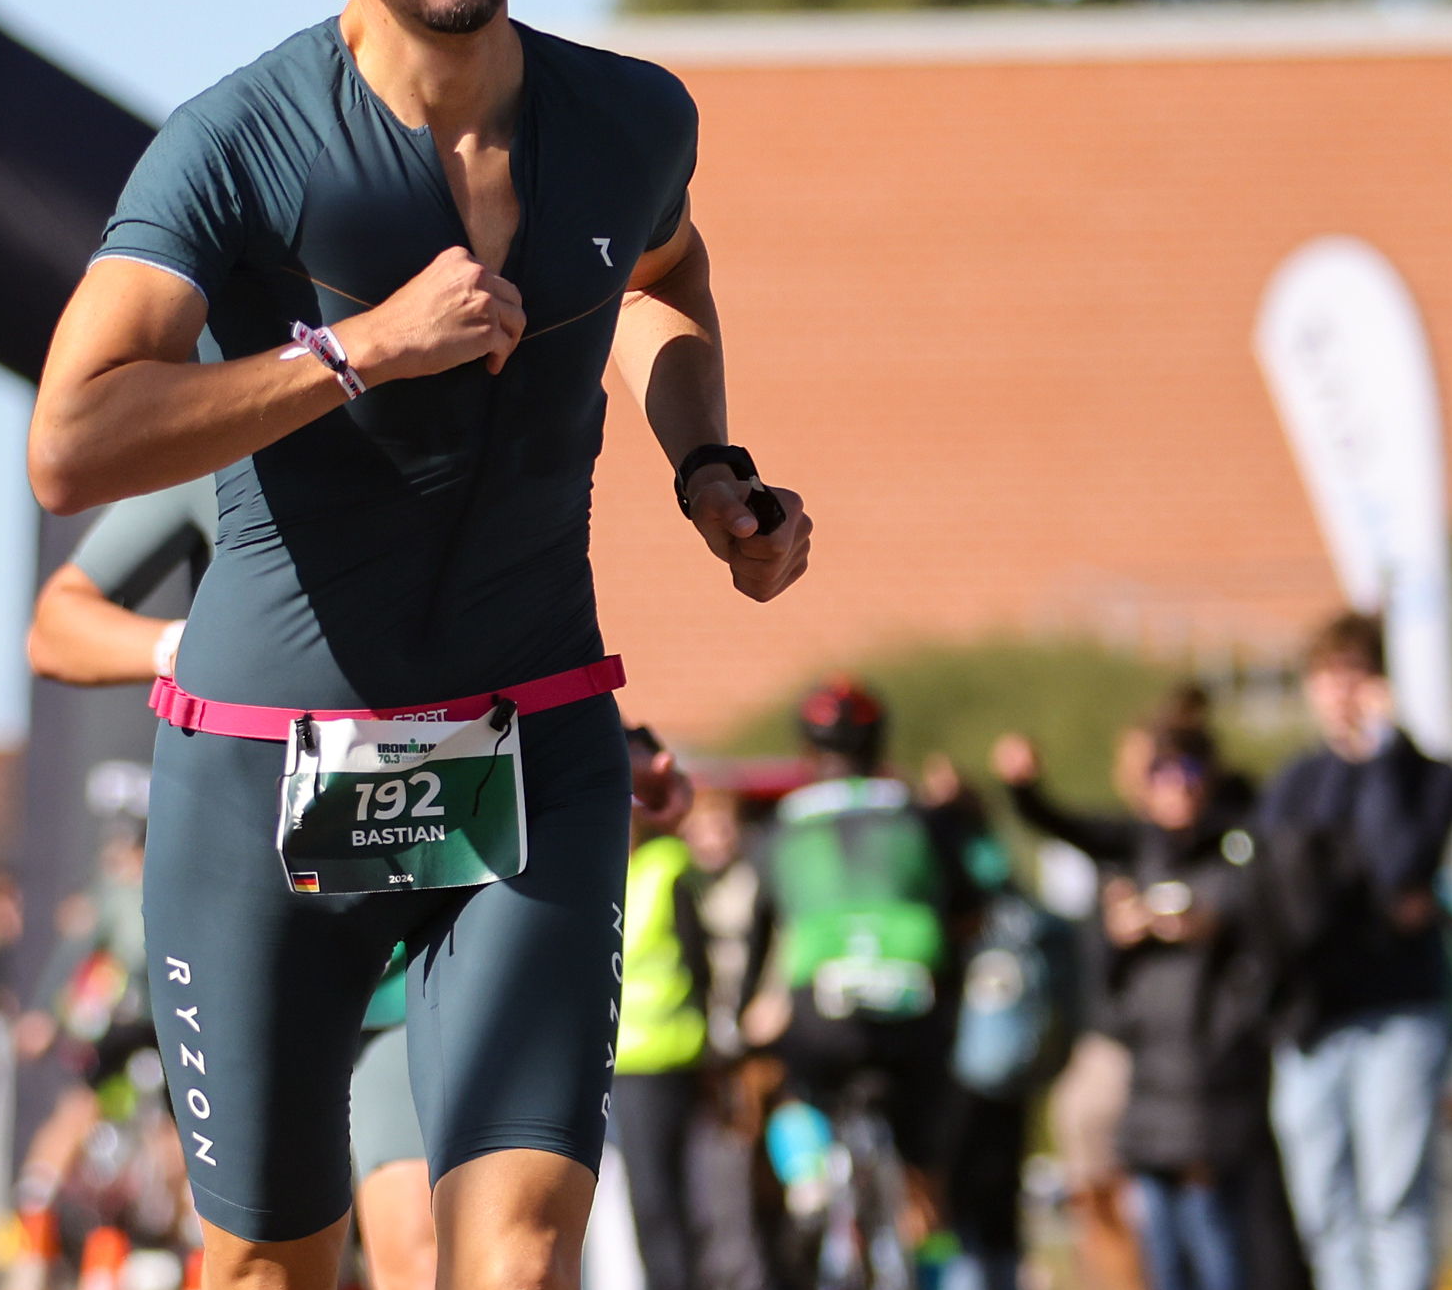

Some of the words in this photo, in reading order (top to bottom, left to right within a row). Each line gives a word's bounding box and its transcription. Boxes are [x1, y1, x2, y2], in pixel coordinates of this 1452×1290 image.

[377, 753, 401, 765] 70.3
[351, 824, 446, 847] BASTIAN
[388, 873, 415, 884] 2024
[165, 955, 217, 1168] RYZON
